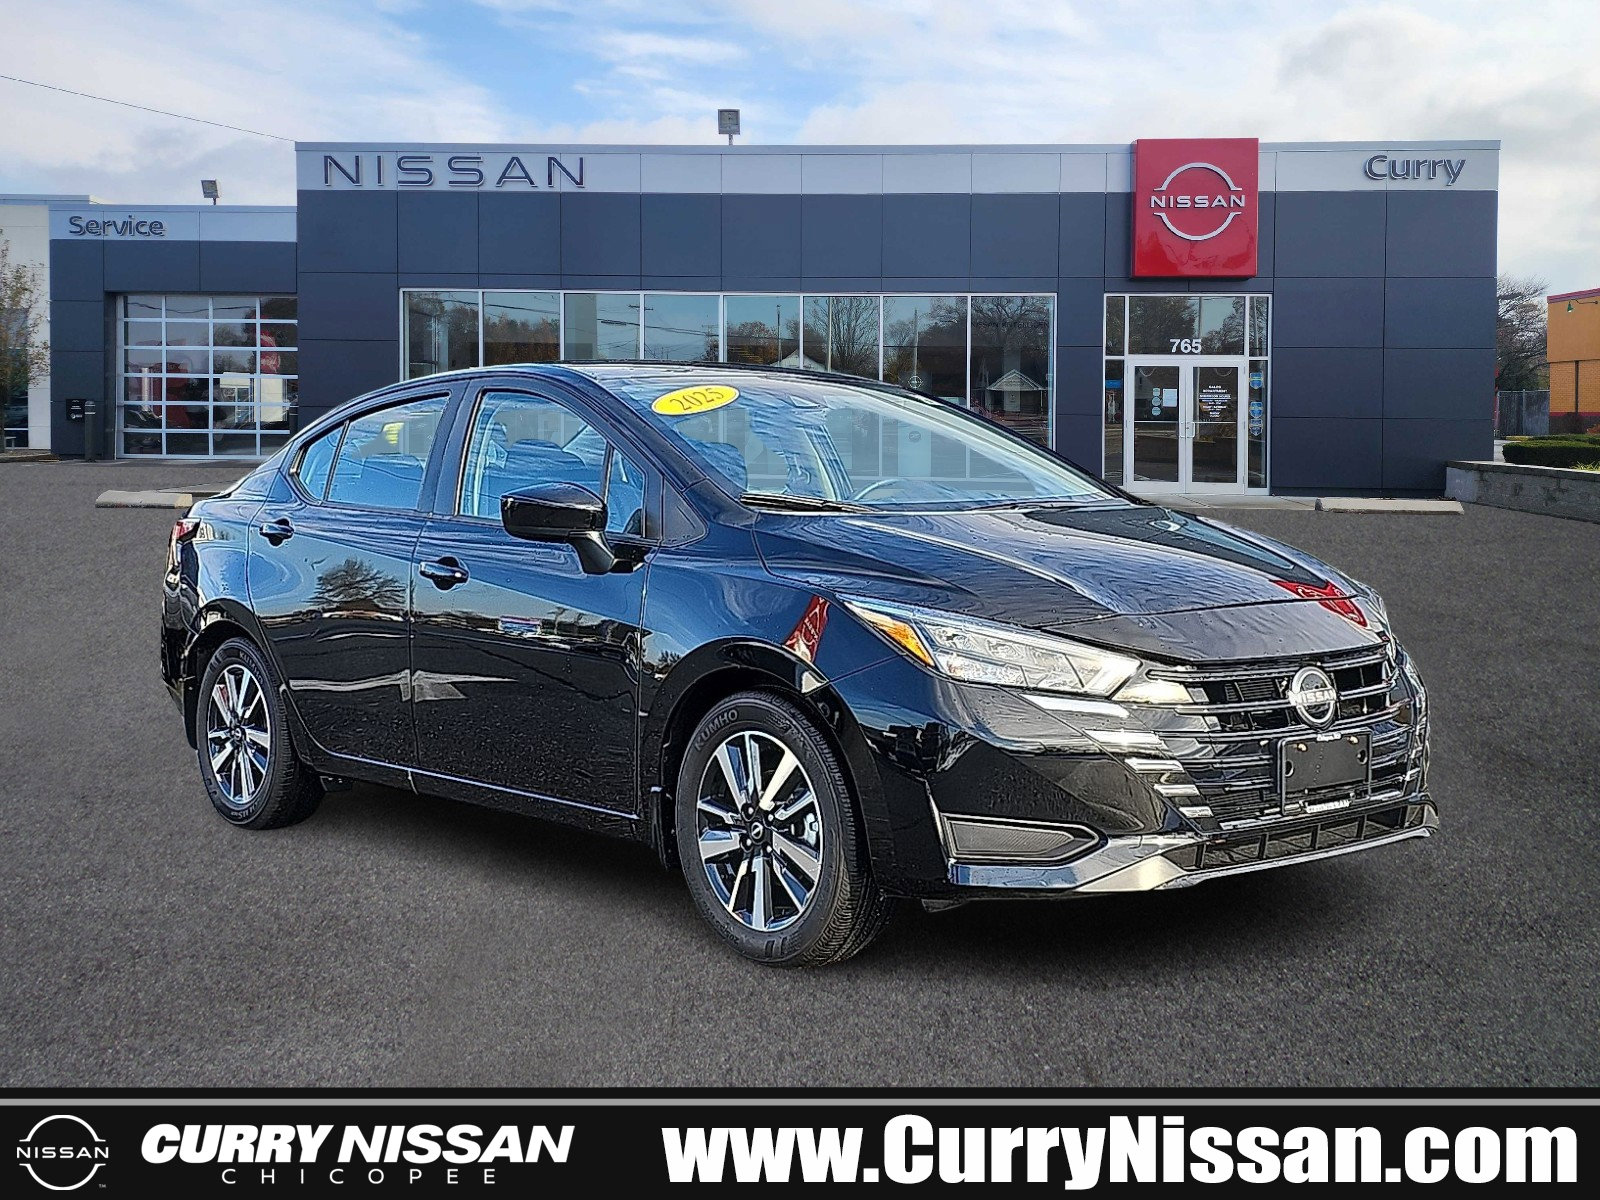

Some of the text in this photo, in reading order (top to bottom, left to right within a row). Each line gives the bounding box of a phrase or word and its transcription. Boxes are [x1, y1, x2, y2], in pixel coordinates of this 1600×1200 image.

[323, 155, 585, 188] NISSAN
[1364, 154, 1466, 186] Curry
[1150, 194, 1245, 208] NISSAN
[69, 215, 165, 236] Service
[1169, 338, 1202, 353] 765
[669, 387, 724, 411] 2025
[694, 709, 738, 751] KUMHO
